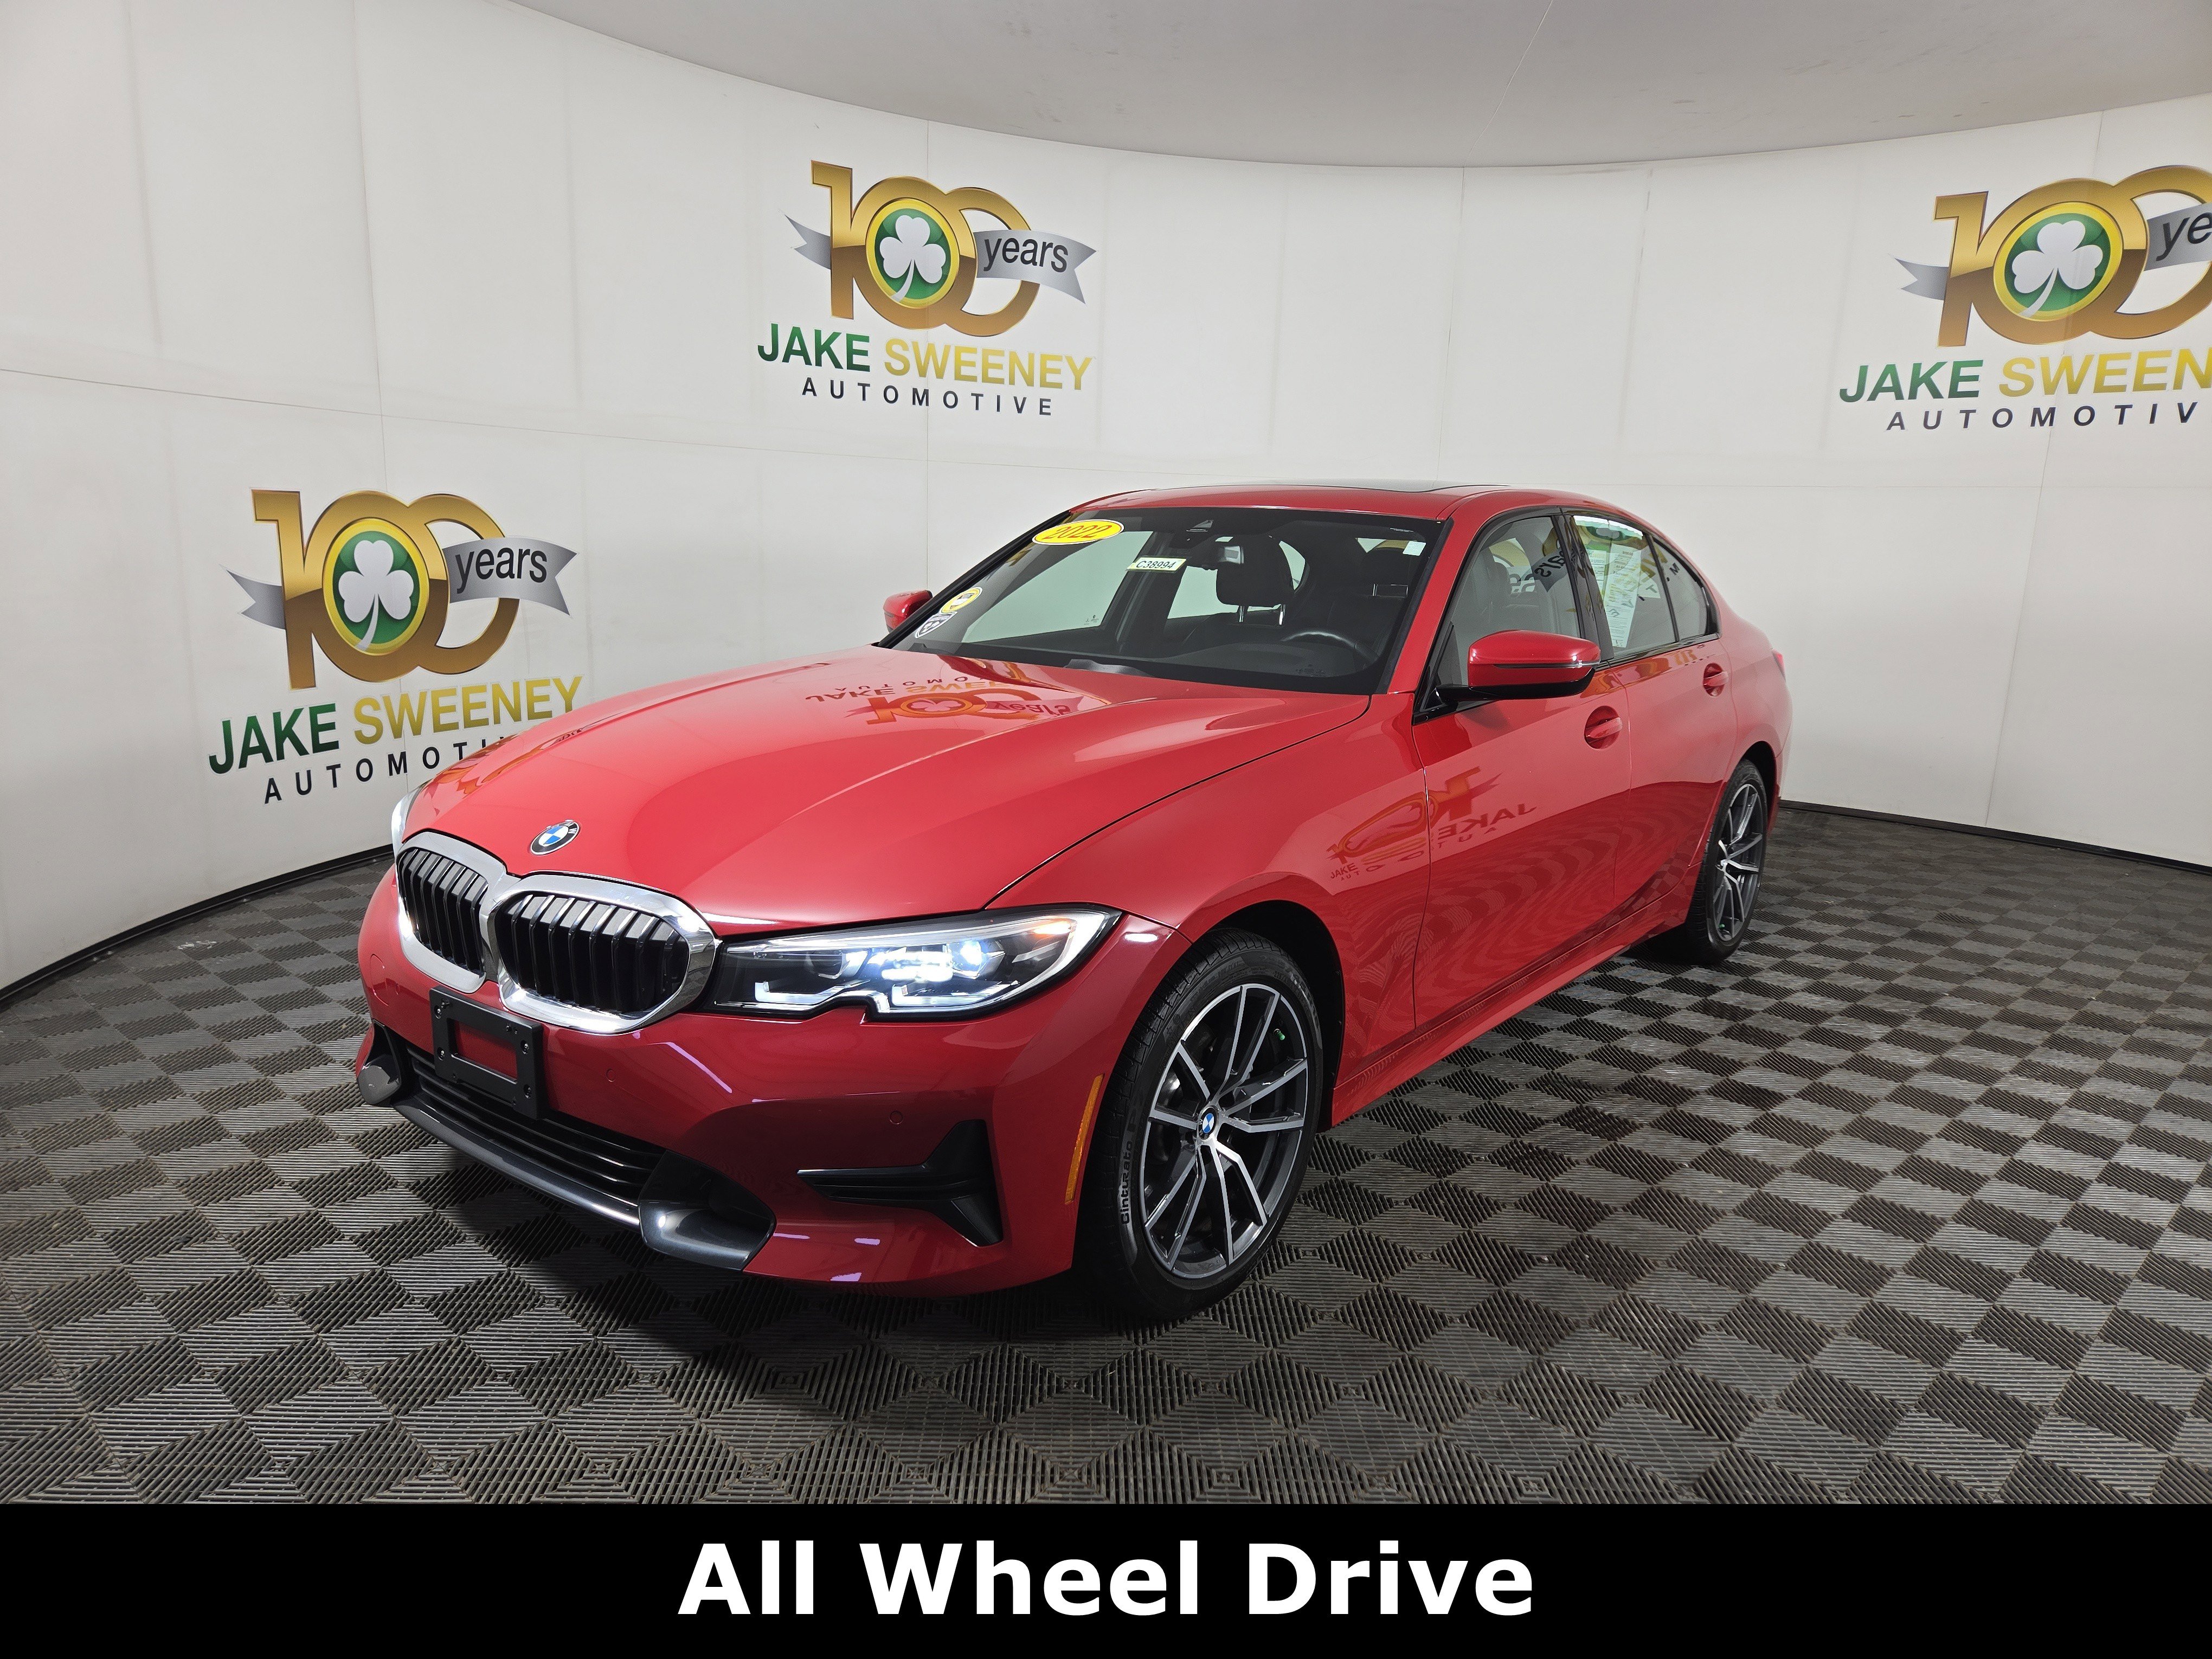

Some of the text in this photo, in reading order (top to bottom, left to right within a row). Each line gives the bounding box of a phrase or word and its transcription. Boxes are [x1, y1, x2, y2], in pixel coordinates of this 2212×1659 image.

[810, 159, 1040, 337] 100
[983, 237, 1069, 273] years
[757, 323, 1093, 391] JAKE SWEENEY
[1839, 346, 2212, 403] JAKE SWEEN
[802, 377, 1052, 416] AUTOMOTIVE
[1886, 401, 2198, 431] AUTOMOTIV
[1041, 525, 1113, 539] 2022
[251, 489, 520, 691] 100
[454, 546, 548, 594] years
[1136, 560, 1176, 569] C38994
[209, 675, 583, 774] JAKE SWEENEY
[264, 736, 504, 805] AUTOMOT
